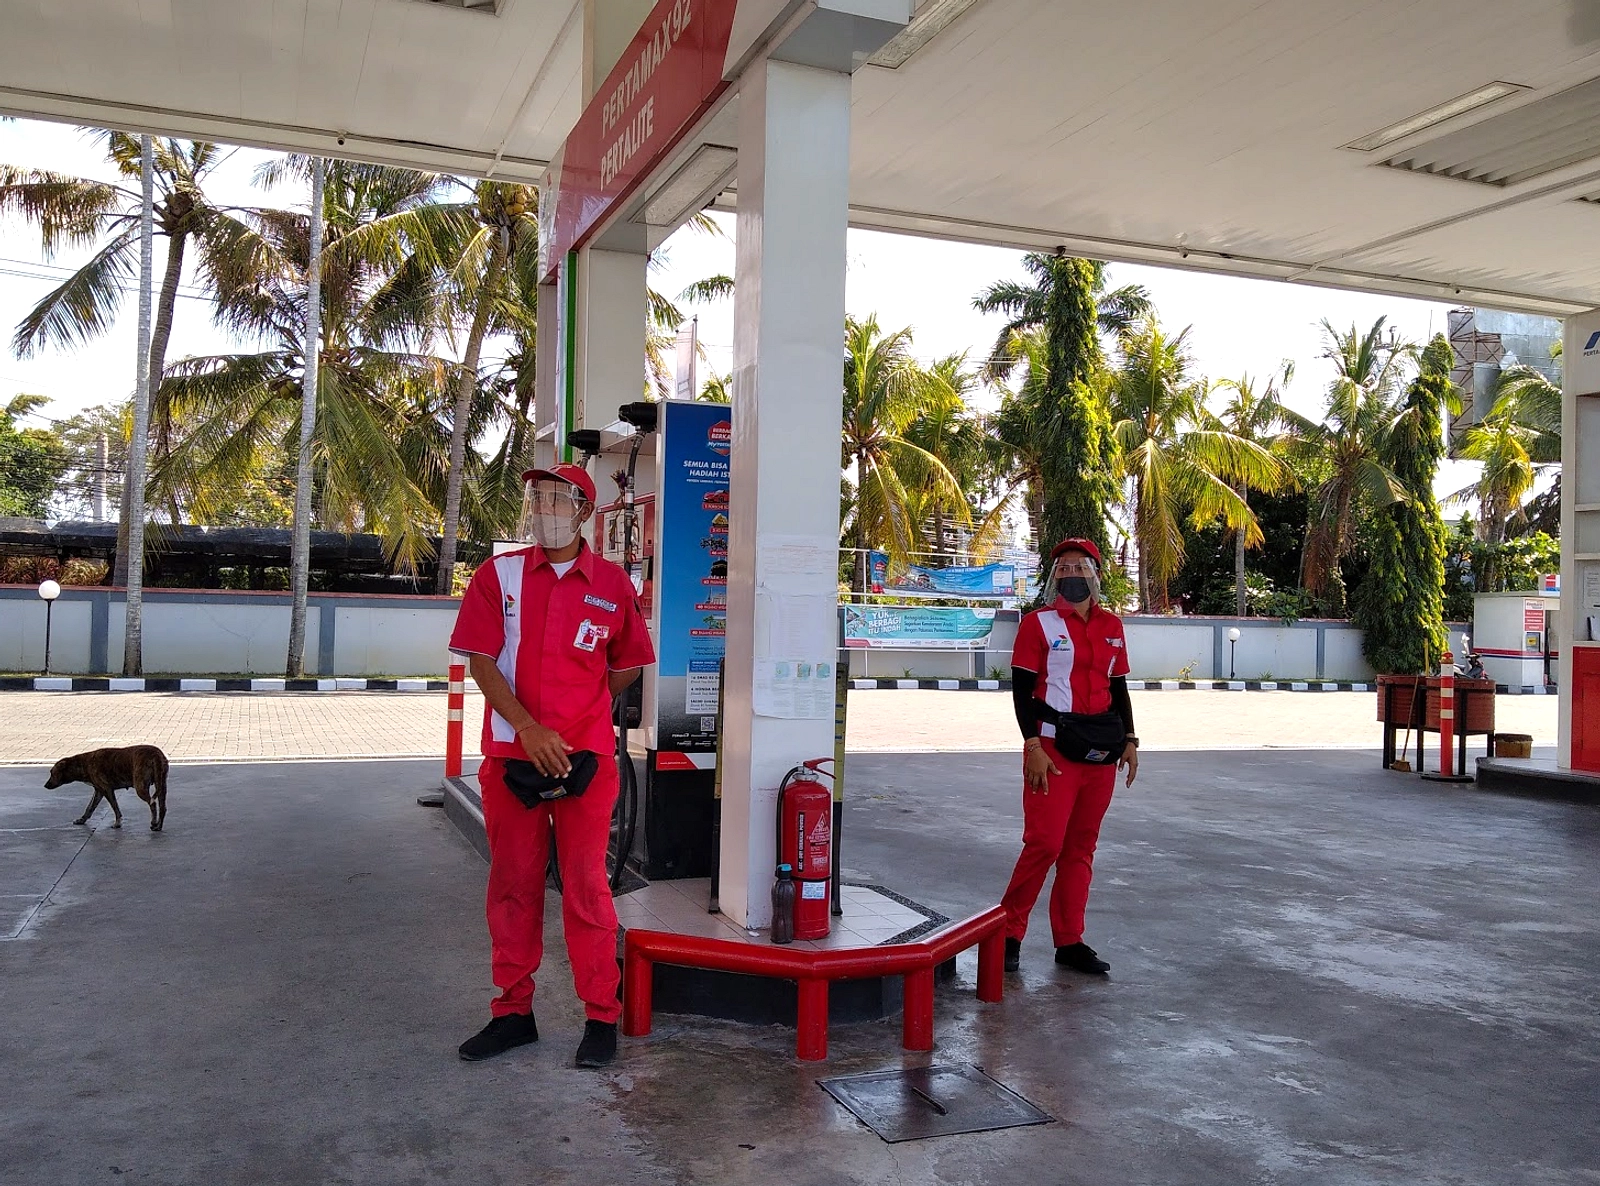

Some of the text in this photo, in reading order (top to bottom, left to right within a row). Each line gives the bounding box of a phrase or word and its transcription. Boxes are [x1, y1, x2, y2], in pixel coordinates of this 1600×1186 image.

[601, 95, 654, 192] PERTALITE
[683, 460, 709, 468] SEMUA
[689, 469, 719, 477] HADIAH
[868, 616, 902, 628] BERBAGI
